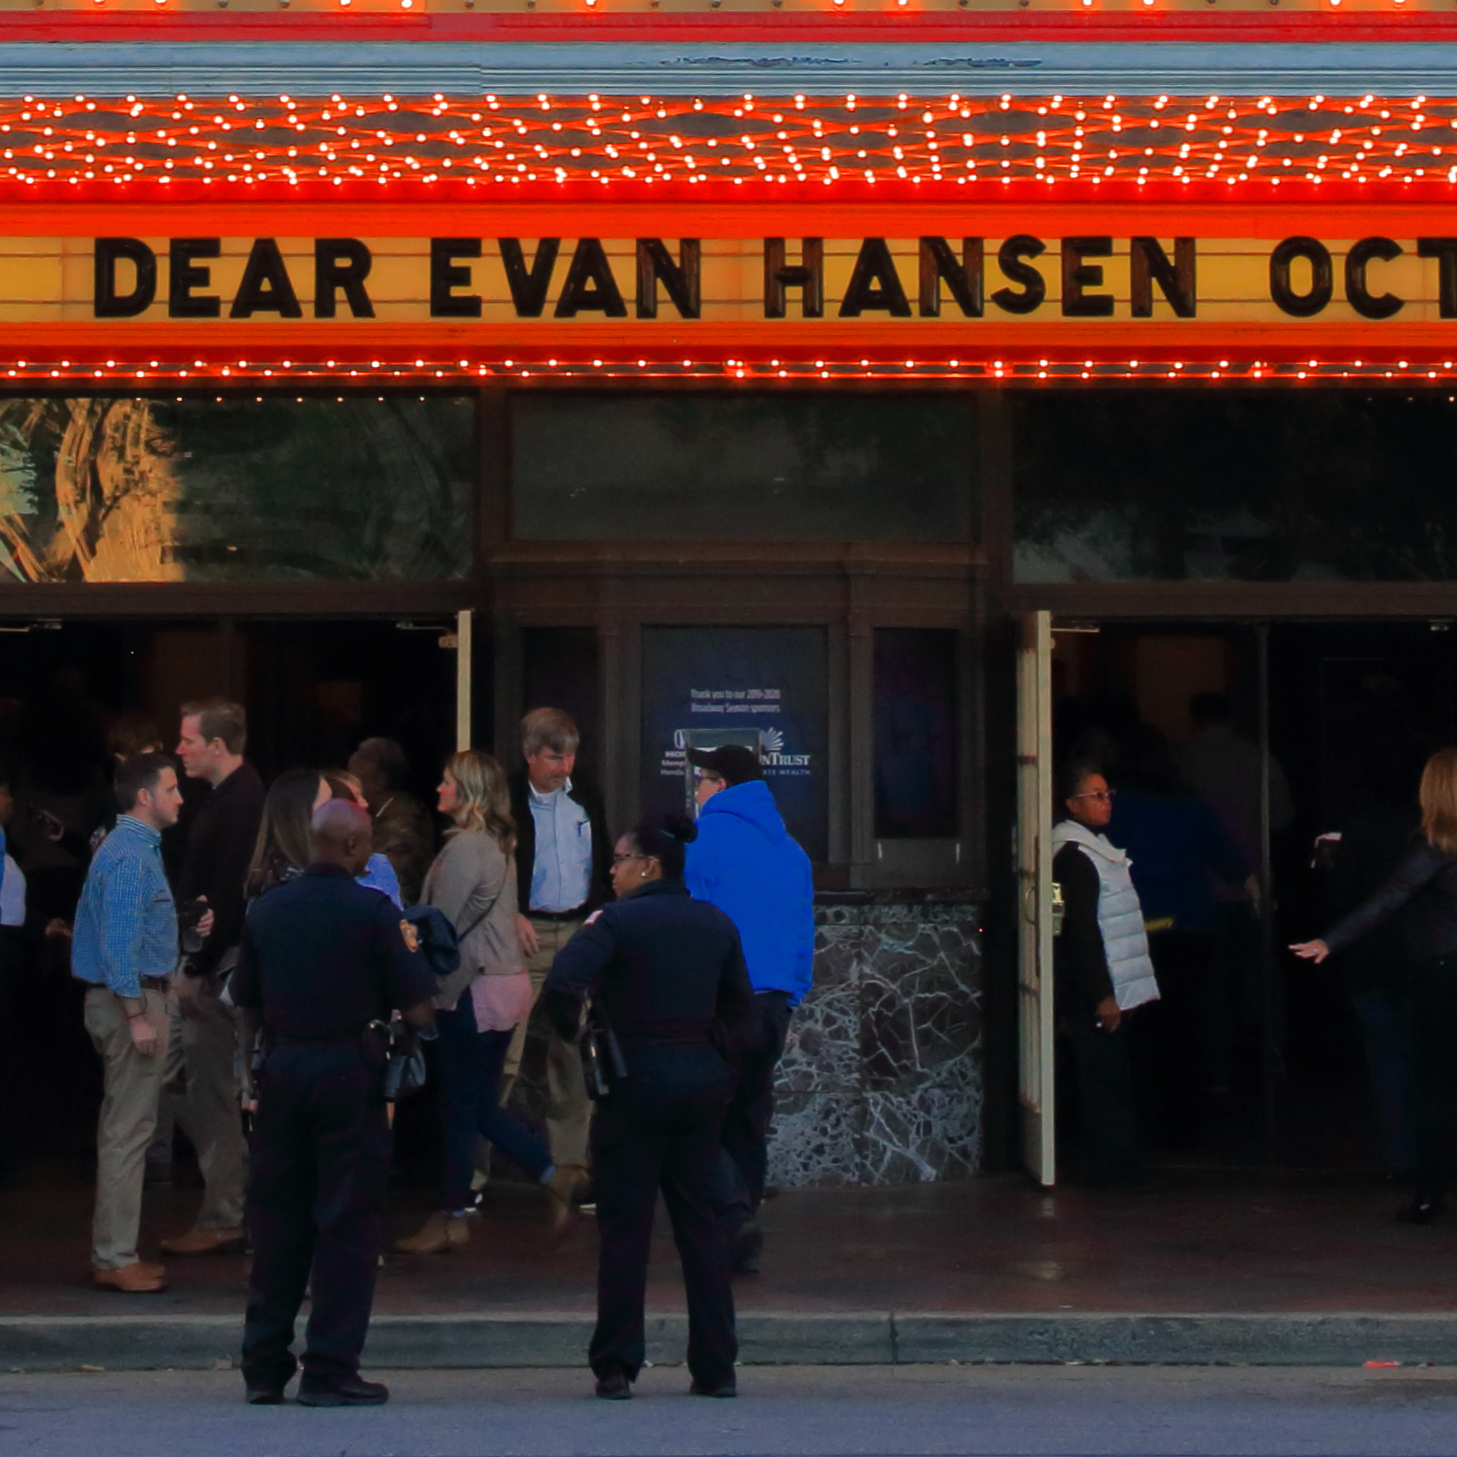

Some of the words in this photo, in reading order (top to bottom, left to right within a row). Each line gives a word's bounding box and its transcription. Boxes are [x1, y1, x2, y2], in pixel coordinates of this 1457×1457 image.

[94, 237, 376, 318] DEAR
[430, 237, 702, 318] EVAN
[763, 236, 1197, 318] HANSEN
